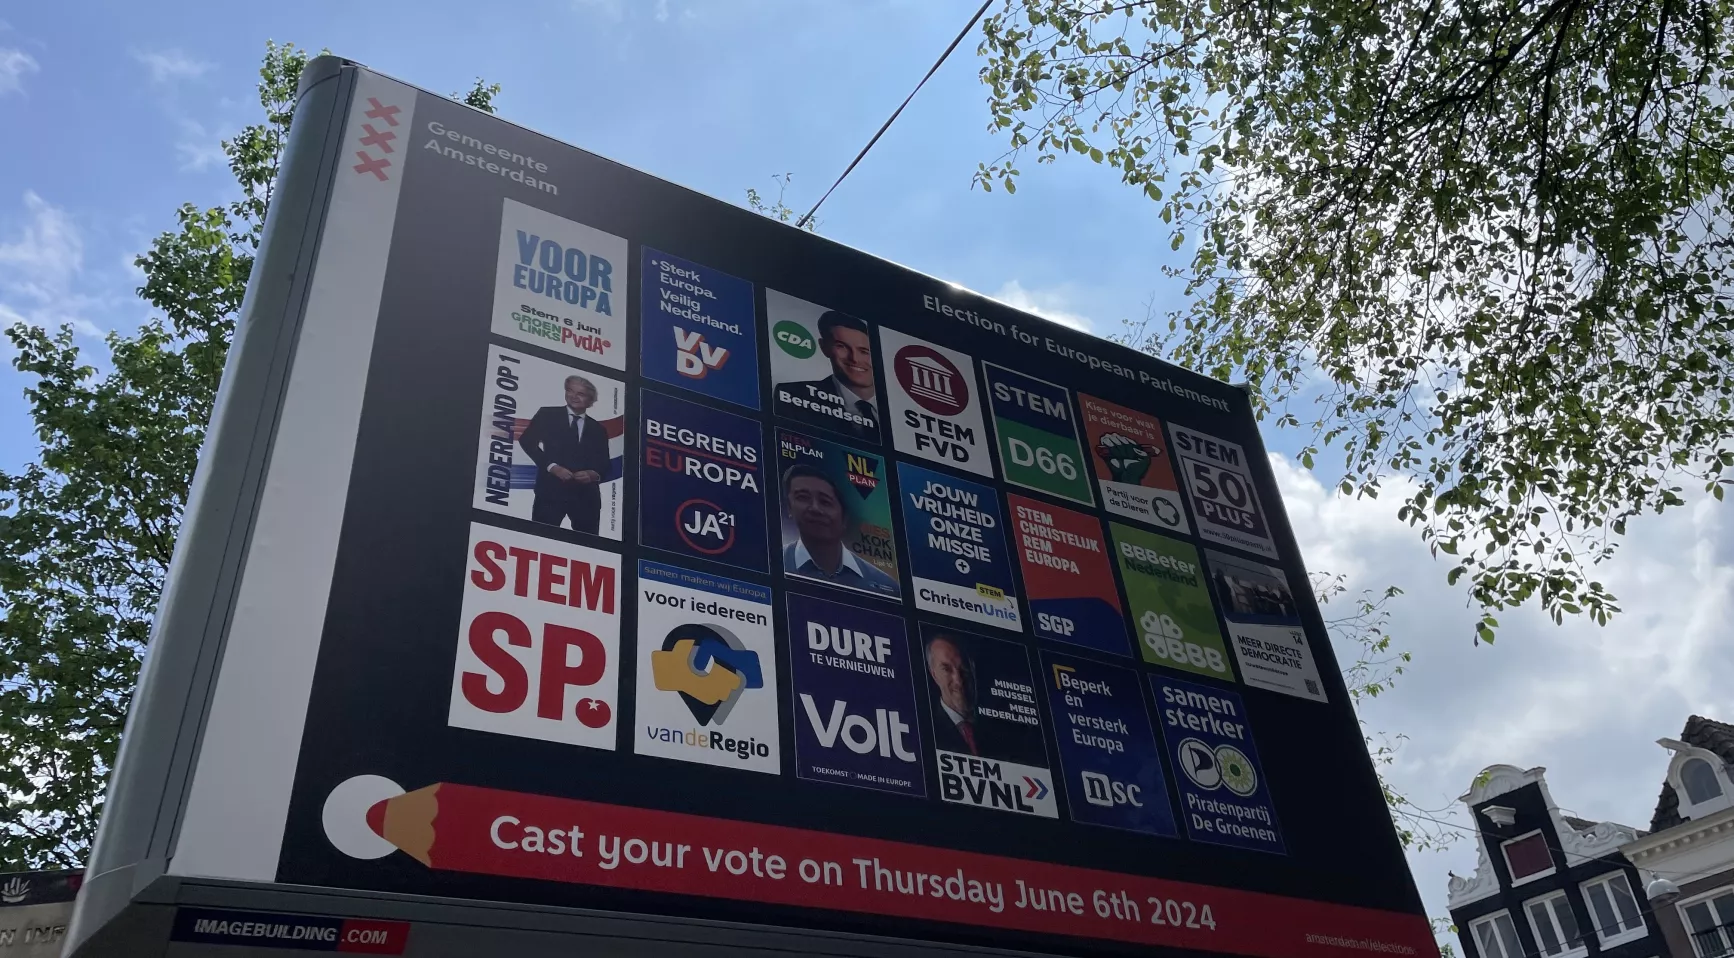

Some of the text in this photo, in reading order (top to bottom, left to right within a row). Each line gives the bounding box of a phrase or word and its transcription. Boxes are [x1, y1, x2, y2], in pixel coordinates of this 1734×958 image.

[428, 121, 548, 173] Gemeente
[424, 139, 558, 195] Amsterdam
[516, 229, 613, 293] VOOR
[660, 260, 700, 282] Sterk
[513, 264, 612, 316] EUROPA
[660, 272, 717, 299] Europa.
[660, 288, 701, 312] Veilig
[511, 312, 561, 333] GROEN
[519, 322, 561, 341] LINKS
[520, 304, 601, 335] Stem 6 juni
[660, 301, 742, 335] Nederland.
[561, 327, 604, 355] PvdA
[777, 330, 812, 349] CDA
[923, 295, 1230, 413] Election for European Parlement
[779, 390, 874, 428] Berendsen
[806, 385, 844, 405] Tom
[994, 382, 1067, 420] STEM
[904, 409, 975, 445] STEM
[1086, 401, 1155, 430] Kies voor wat
[1088, 411, 1098, 422] je
[1101, 414, 1143, 436] dierbaar
[485, 354, 520, 506] NEDERLAND OP 1
[646, 419, 757, 463] BEGRENS
[781, 440, 823, 459] NLPLAN
[782, 450, 797, 460] EU
[915, 432, 969, 463] FVD
[1007, 437, 1077, 480] D66
[1176, 431, 1239, 466] STEM
[645, 447, 759, 493] EUROPA
[847, 453, 874, 477] NL
[849, 474, 876, 488] PLAN
[923, 480, 978, 507] JOUW
[1193, 463, 1247, 508] 50
[909, 492, 996, 528] VRIJHEID
[1107, 487, 1149, 506] Partij voor
[1110, 497, 1149, 515] de Dieren
[1016, 505, 1054, 526] STEM
[1201, 500, 1254, 528] PLUS
[861, 533, 892, 550] KOK
[930, 517, 983, 543] ONZE
[1019, 520, 1100, 552] CHRISTELIJK
[1022, 534, 1053, 553] REM
[852, 542, 892, 562] CHAN
[928, 533, 991, 563] MISSIE
[1025, 548, 1080, 575] EUROPA
[1119, 541, 1196, 575] BBBeter
[471, 540, 615, 615] STEM
[644, 565, 766, 599] samen maken wij Europa
[1125, 558, 1199, 588] Nederland
[919, 588, 1017, 622] ChristenUnie
[979, 586, 1002, 598] STEM
[644, 590, 767, 626] voor iedereen
[1037, 612, 1075, 636] SGP
[807, 621, 892, 663] DURF
[1237, 635, 1303, 659] MEER DIRECTE
[810, 652, 895, 679] TE VERNIEUWEN
[1240, 647, 1303, 669] DEMOCRATIE
[991, 688, 1035, 704] BRUSSEL
[994, 678, 1033, 694] MINDER
[1060, 672, 1113, 697] Beperk
[1009, 703, 1037, 716] MEER
[1065, 690, 1083, 708] én
[1162, 685, 1236, 716] samen
[799, 692, 917, 762] Volt
[978, 706, 1039, 726] NEDERLAND
[1067, 712, 1129, 735] versterk
[1165, 708, 1244, 740] sterker
[647, 726, 769, 760] vandeRegio
[1072, 728, 1124, 755] Europa
[812, 765, 912, 788] TOEKOMST MADE IN EUROPE
[940, 753, 1003, 781] STEM
[942, 772, 1034, 813] BVNL
[1187, 792, 1271, 826] Piratenpartij
[1192, 813, 1277, 843] De Groenen
[489, 815, 1217, 931] Cast your vote on Thursday June 6th 2024
